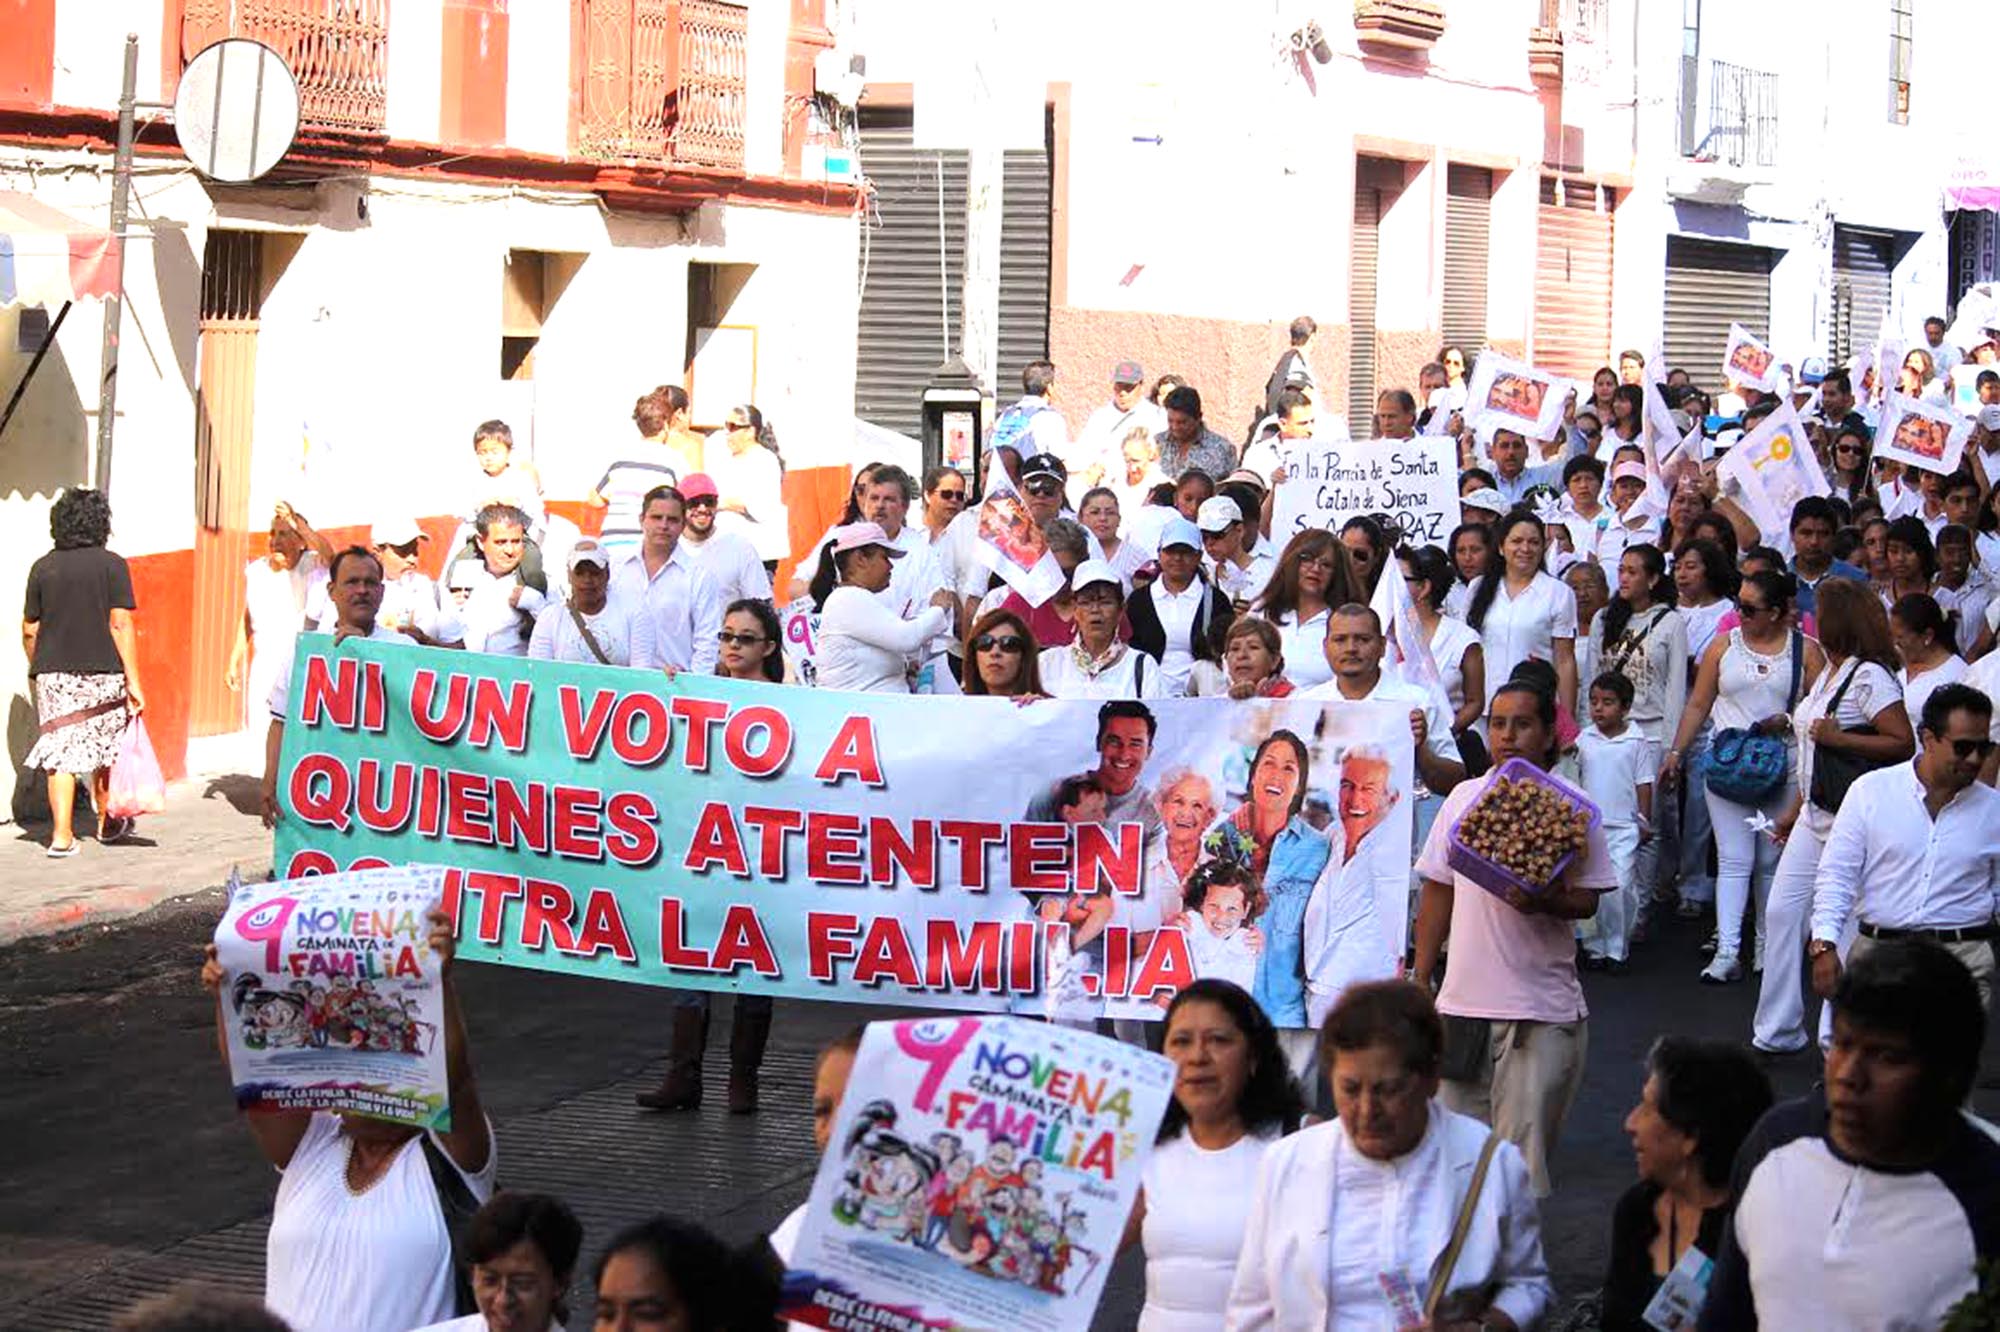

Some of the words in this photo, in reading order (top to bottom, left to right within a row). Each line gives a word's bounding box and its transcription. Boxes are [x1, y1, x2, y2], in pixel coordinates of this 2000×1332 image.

[1305, 452, 1319, 479] la
[1370, 459, 1383, 480] de
[1390, 450, 1439, 476] Santa
[1381, 480, 1428, 509] Siena
[300, 654, 385, 731] NI
[409, 668, 532, 751] UN
[558, 685, 793, 777] VOTO
[814, 712, 885, 786] A
[288, 752, 660, 865] QUIENES
[683, 801, 1145, 896] ATENTEN
[234, 896, 298, 974] 9
[297, 907, 418, 941] NOVENA
[658, 897, 781, 978] LA
[893, 1015, 983, 1115] 9
[968, 1074, 1074, 1126] CAMINATA
[973, 1041, 1133, 1127] NOVENA
